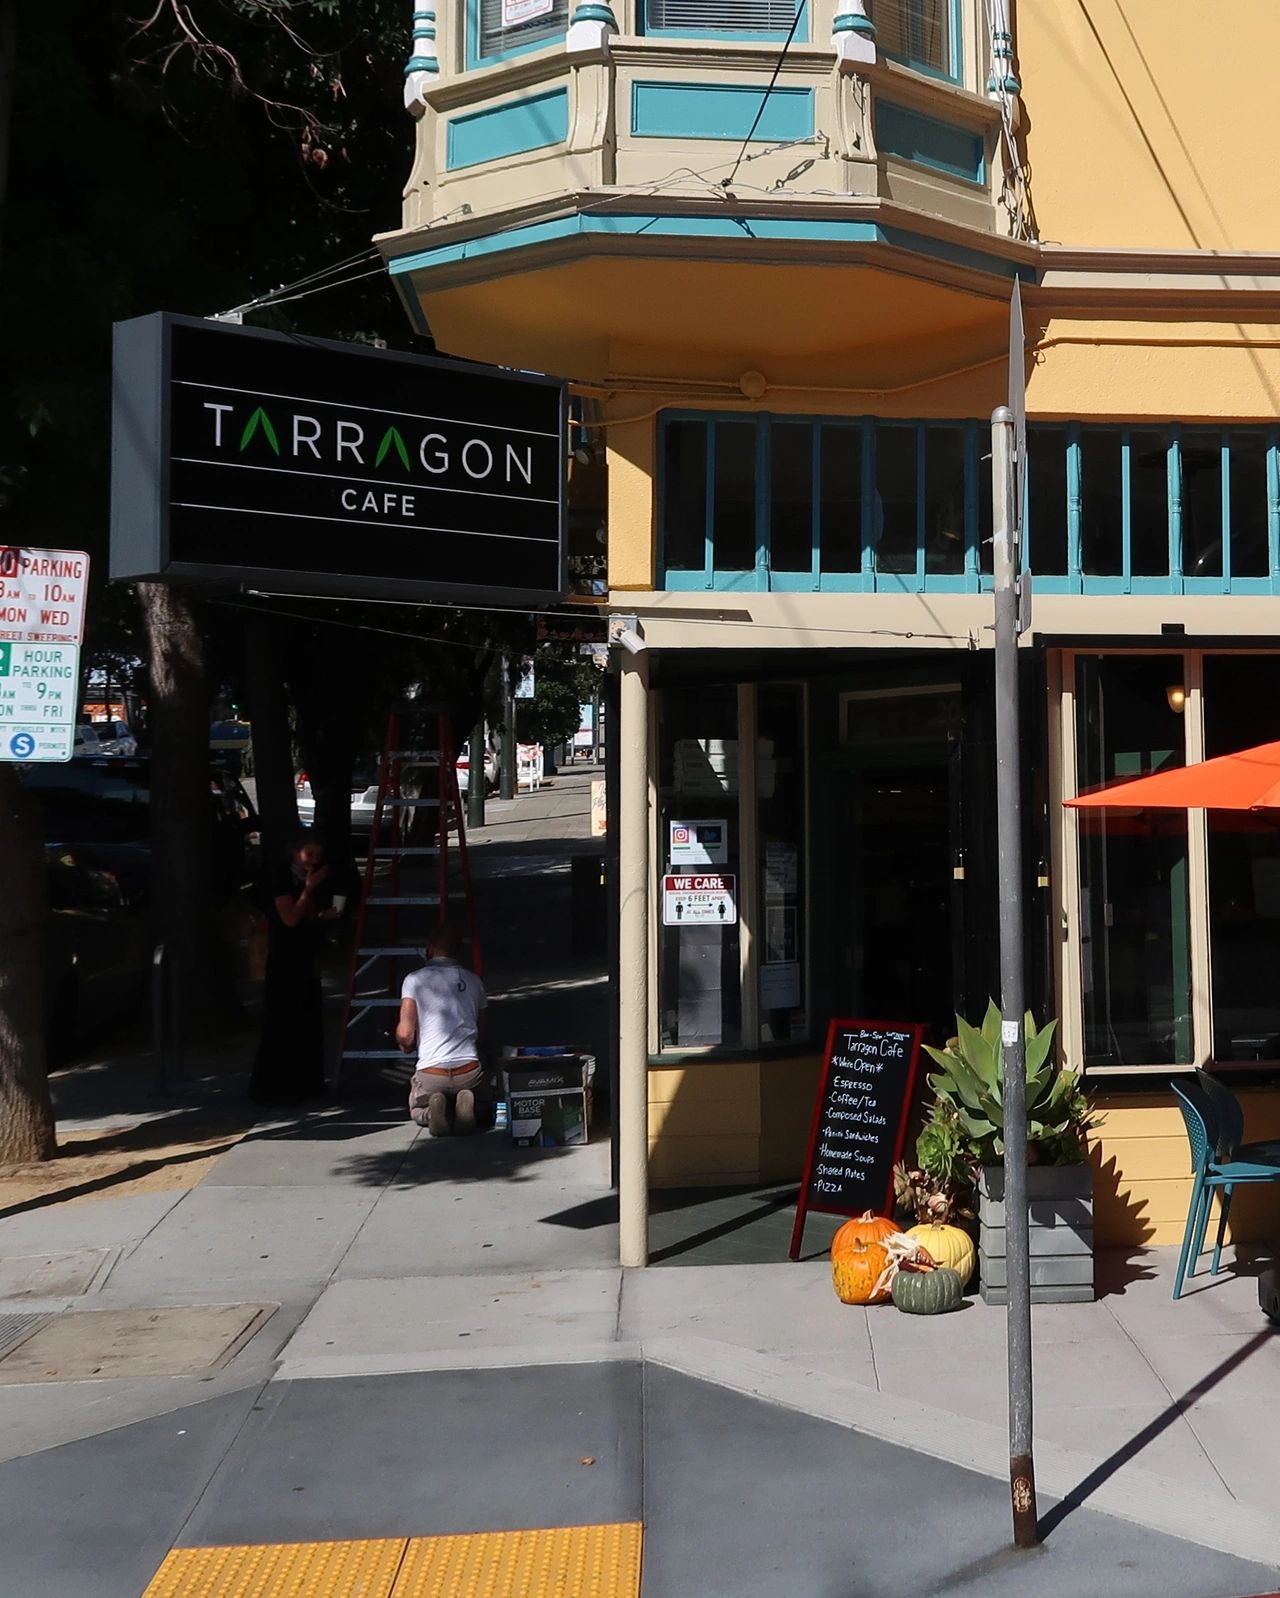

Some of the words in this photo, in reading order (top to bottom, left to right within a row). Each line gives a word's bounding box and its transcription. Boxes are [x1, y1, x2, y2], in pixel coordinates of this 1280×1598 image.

[203, 402, 532, 484] TARRAGON
[341, 488, 416, 516] CAFE
[22, 558, 82, 578] PARKING
[41, 610, 69, 625] WED
[24, 650, 62, 662] HOUR
[12, 665, 72, 678] PARKING
[43, 705, 63, 717] FRI
[673, 877, 692, 890] WE
[694, 877, 725, 890] CARE
[688, 894, 693, 902] 6
[694, 894, 710, 902] FEET
[843, 1033, 878, 1056] Tarragon
[880, 1039, 904, 1058] Cafe
[513, 1098, 545, 1108] MOTOR
[518, 1106, 541, 1114] BASE
[854, 1149, 875, 1164] Soups
